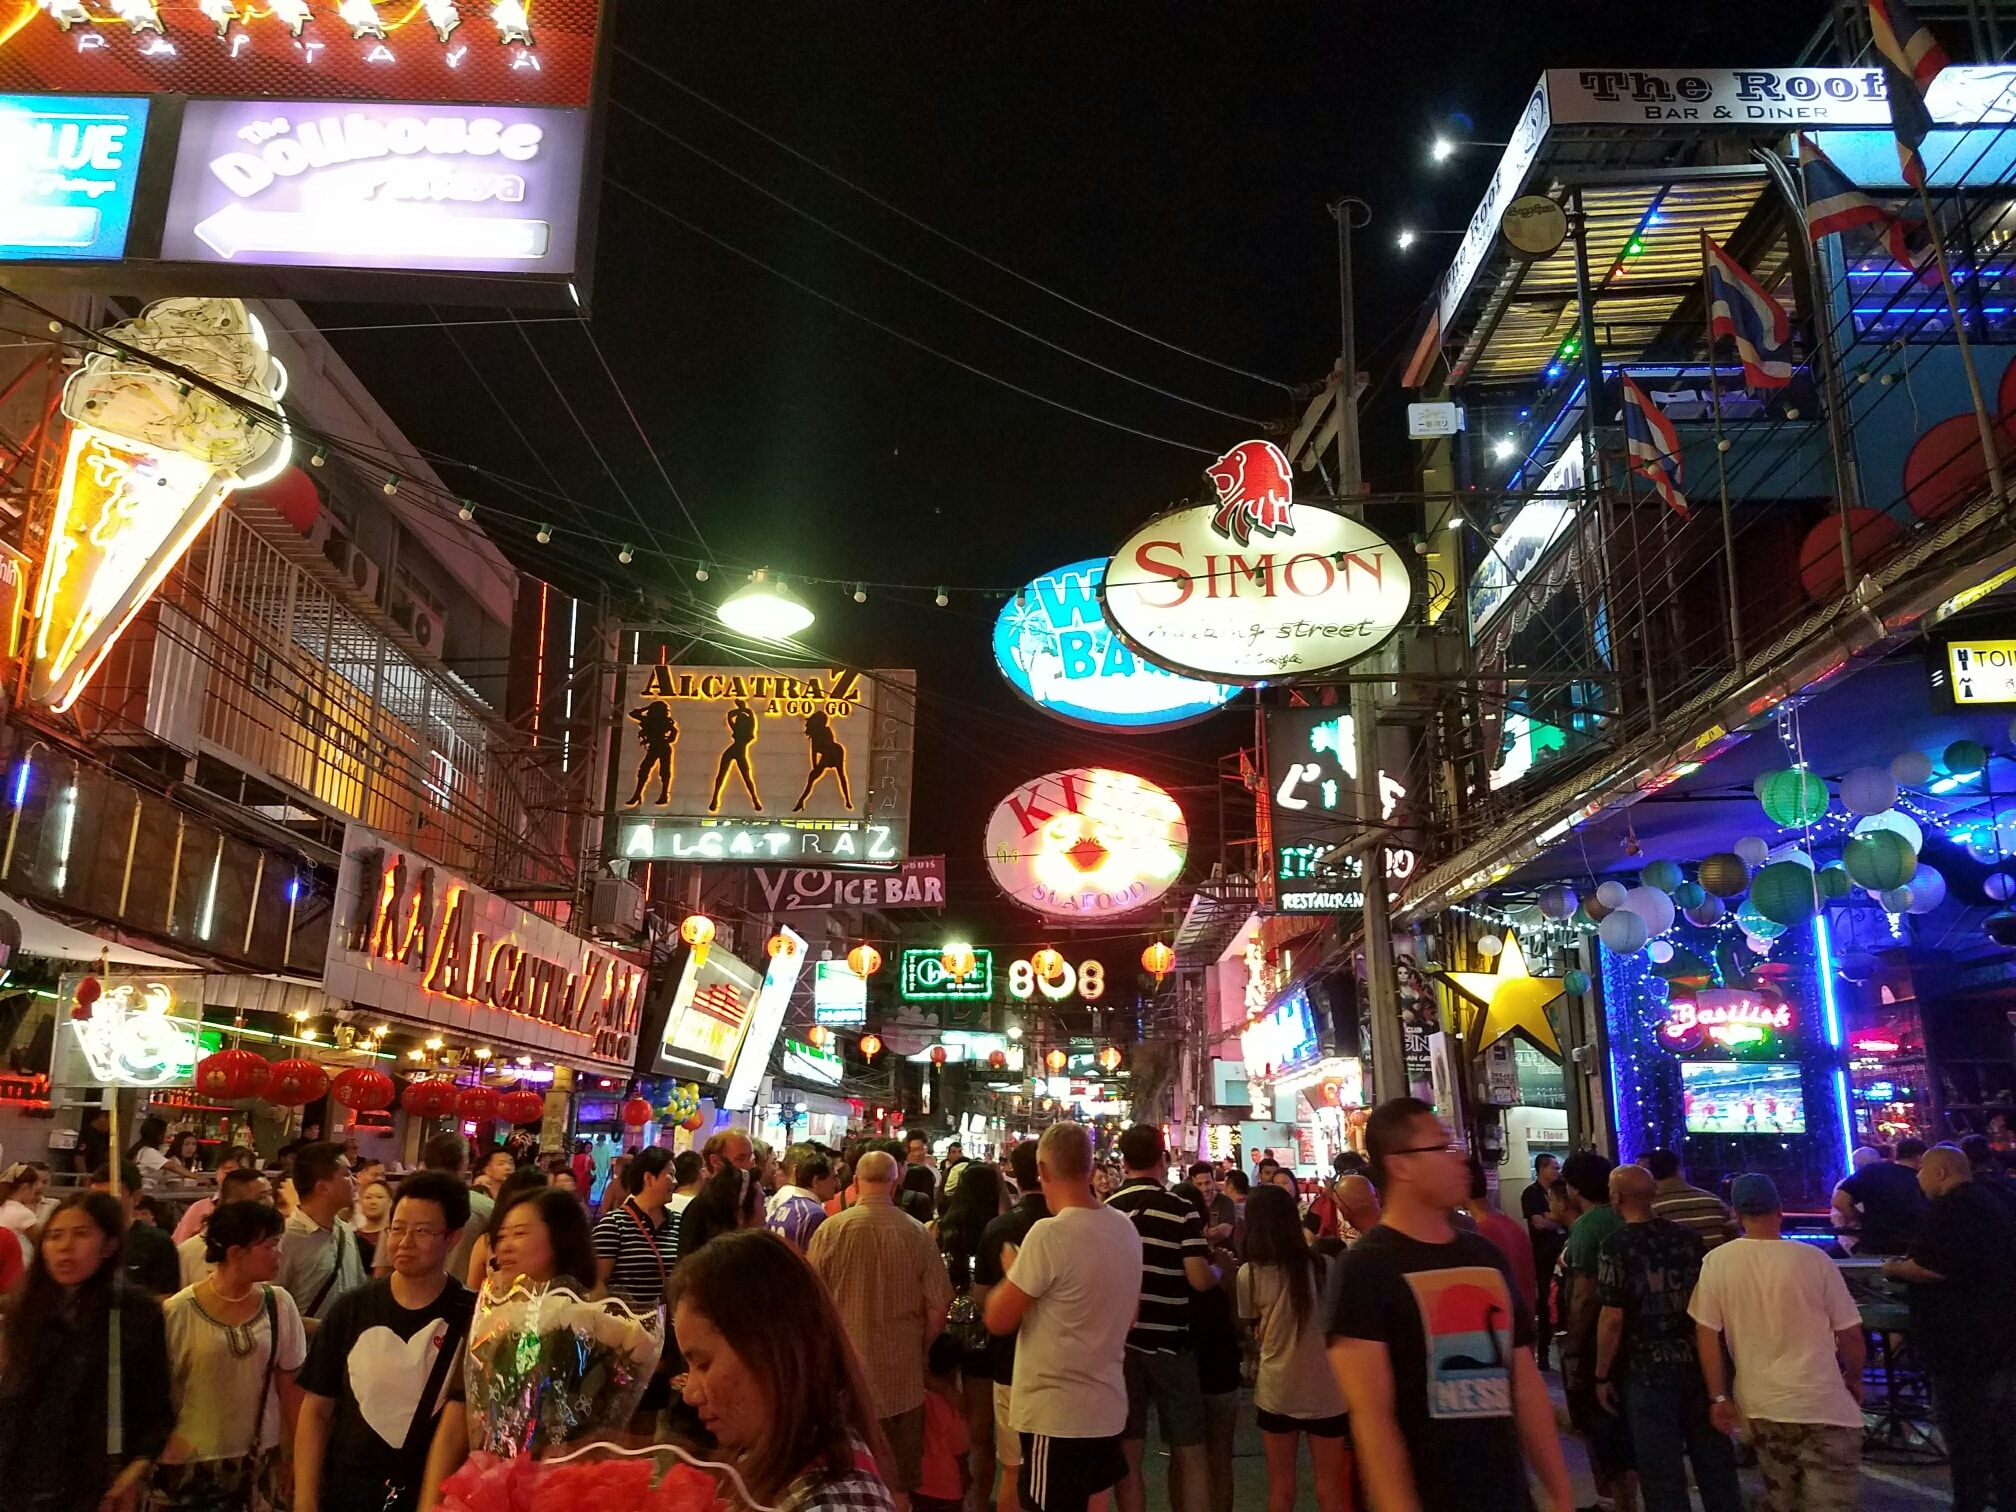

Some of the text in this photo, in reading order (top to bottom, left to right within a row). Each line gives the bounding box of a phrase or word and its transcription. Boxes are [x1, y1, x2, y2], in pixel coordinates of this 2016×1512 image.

[1577, 70, 1886, 102] The Roof
[1711, 106, 1732, 119] &
[209, 113, 543, 198] Dollhouse
[1470, 168, 1501, 244] Roof
[1136, 540, 1384, 609] SIMON
[1276, 618, 1375, 640] street
[1974, 651, 2016, 667] TOI
[640, 665, 860, 699] ALCATRAZ
[766, 699, 850, 716] A GO GO
[626, 825, 896, 858] ALCATRAZ
[885, 875, 943, 904] BAR
[1031, 880, 1148, 911] SEAFOOD
[1009, 959, 1105, 1000] 808
